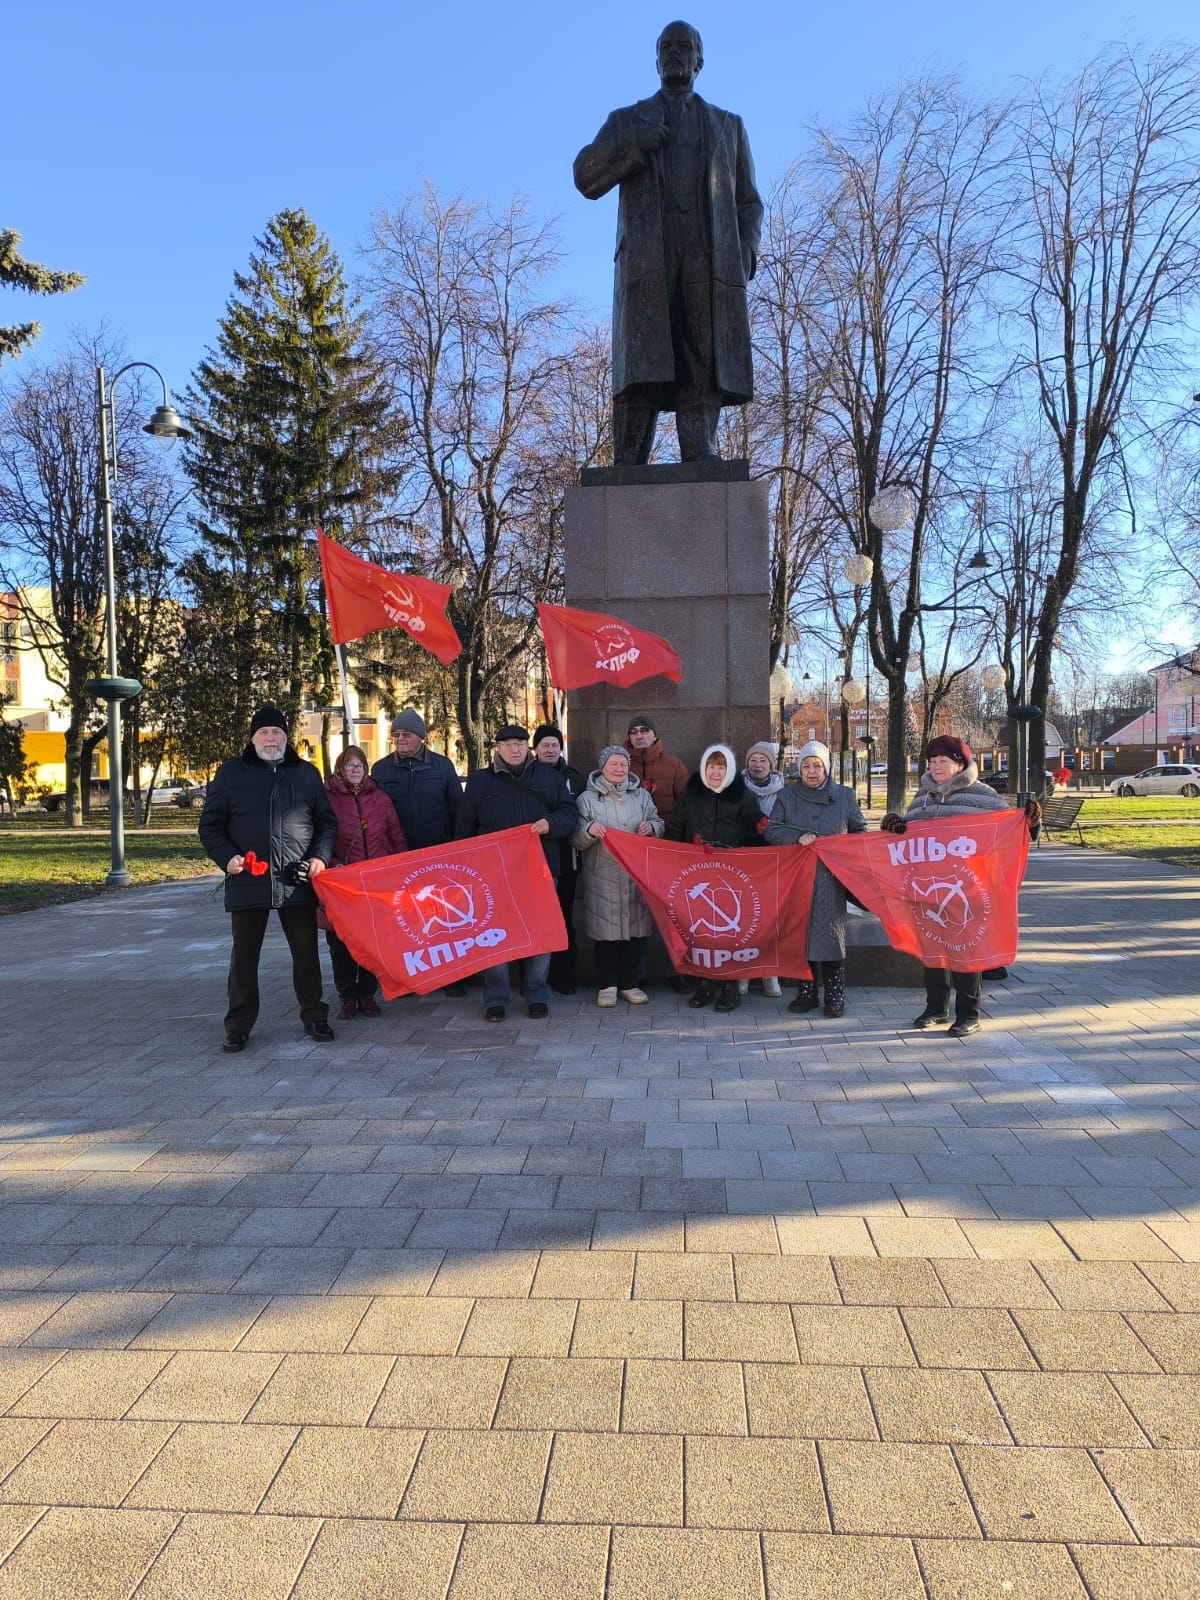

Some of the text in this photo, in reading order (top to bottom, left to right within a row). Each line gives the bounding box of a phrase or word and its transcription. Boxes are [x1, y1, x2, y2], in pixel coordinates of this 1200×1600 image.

[383, 603, 426, 632] ПРФ
[595, 648, 640, 672] КПРФ
[403, 863, 478, 885] НАРОДОВЛАСТИЕ
[681, 861, 750, 884] НАРОДОВЛАСТИЕ
[403, 928, 507, 977] КПРФ
[691, 947, 760, 969] ПРФ
